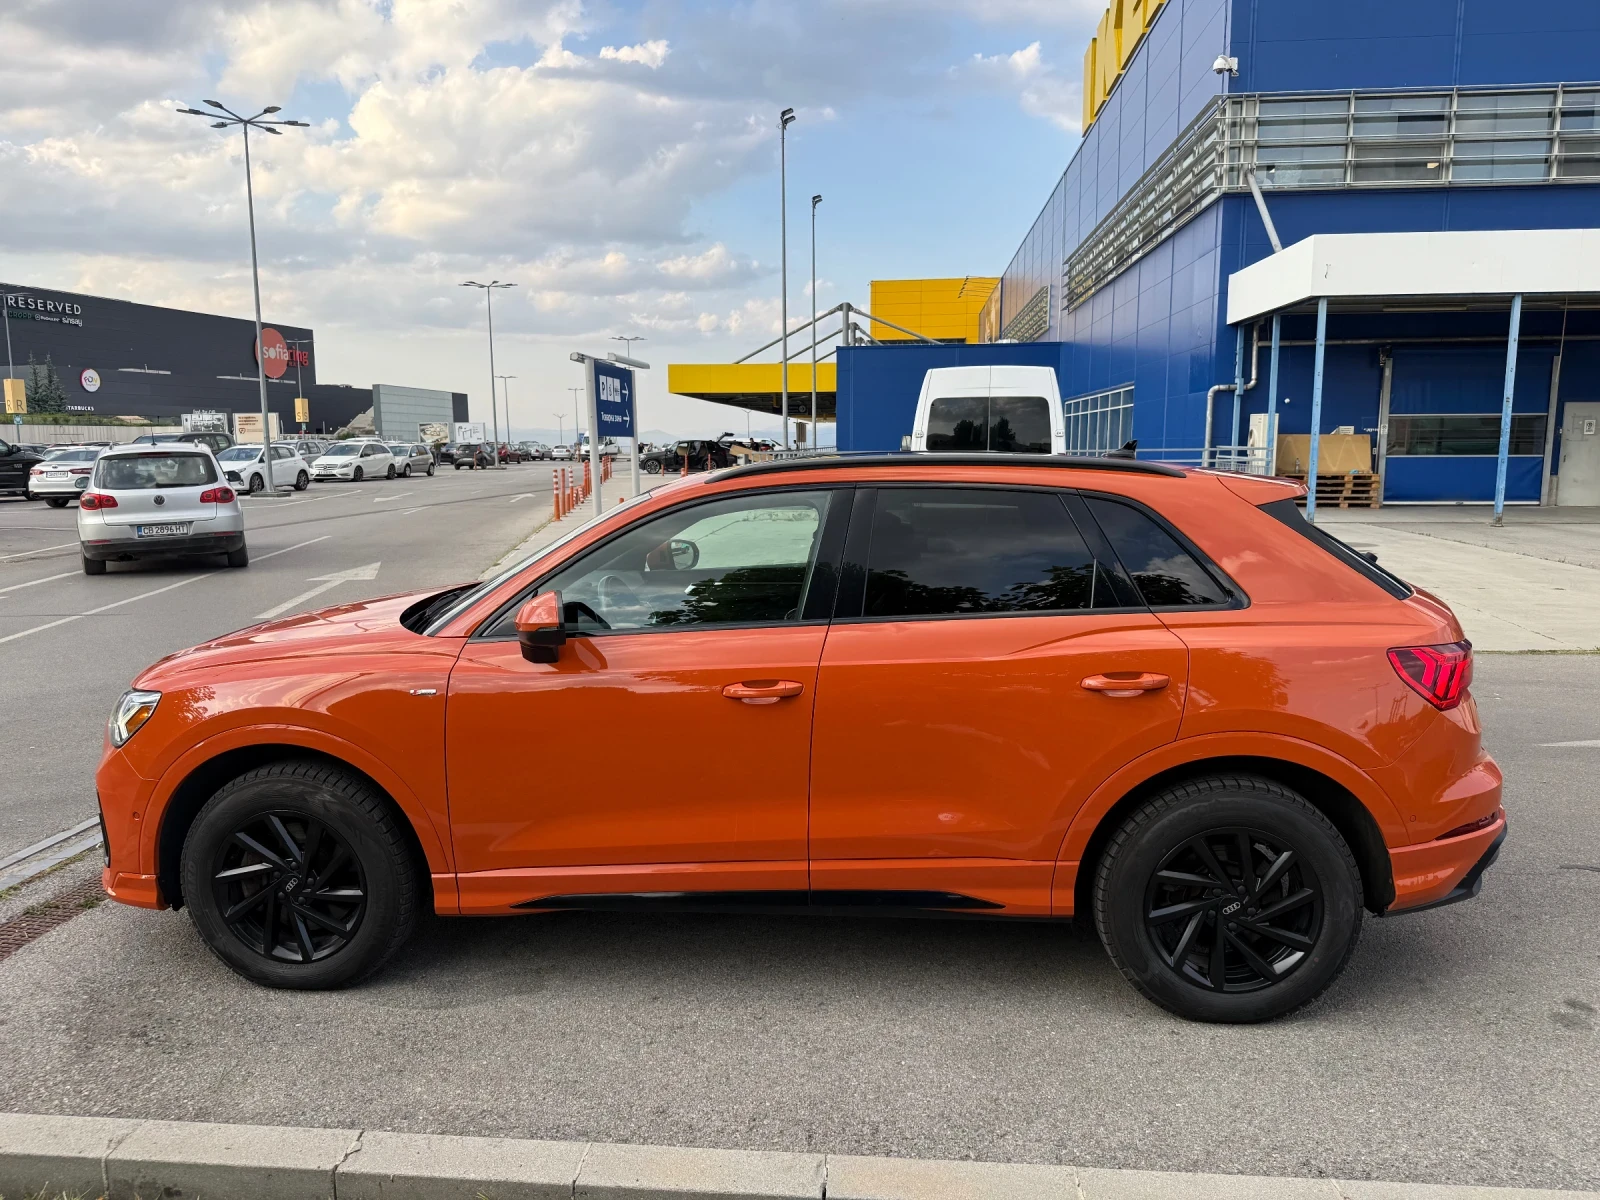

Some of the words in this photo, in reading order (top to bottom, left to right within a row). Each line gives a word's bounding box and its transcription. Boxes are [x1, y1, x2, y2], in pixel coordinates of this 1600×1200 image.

[7, 296, 82, 315] RESERVED
[62, 316, 82, 327] sinsay
[16, 399, 24, 411] R
[296, 411, 302, 420] S
[143, 527, 154, 535] CB
[155, 526, 175, 534] 2896
[175, 525, 186, 533] HT
